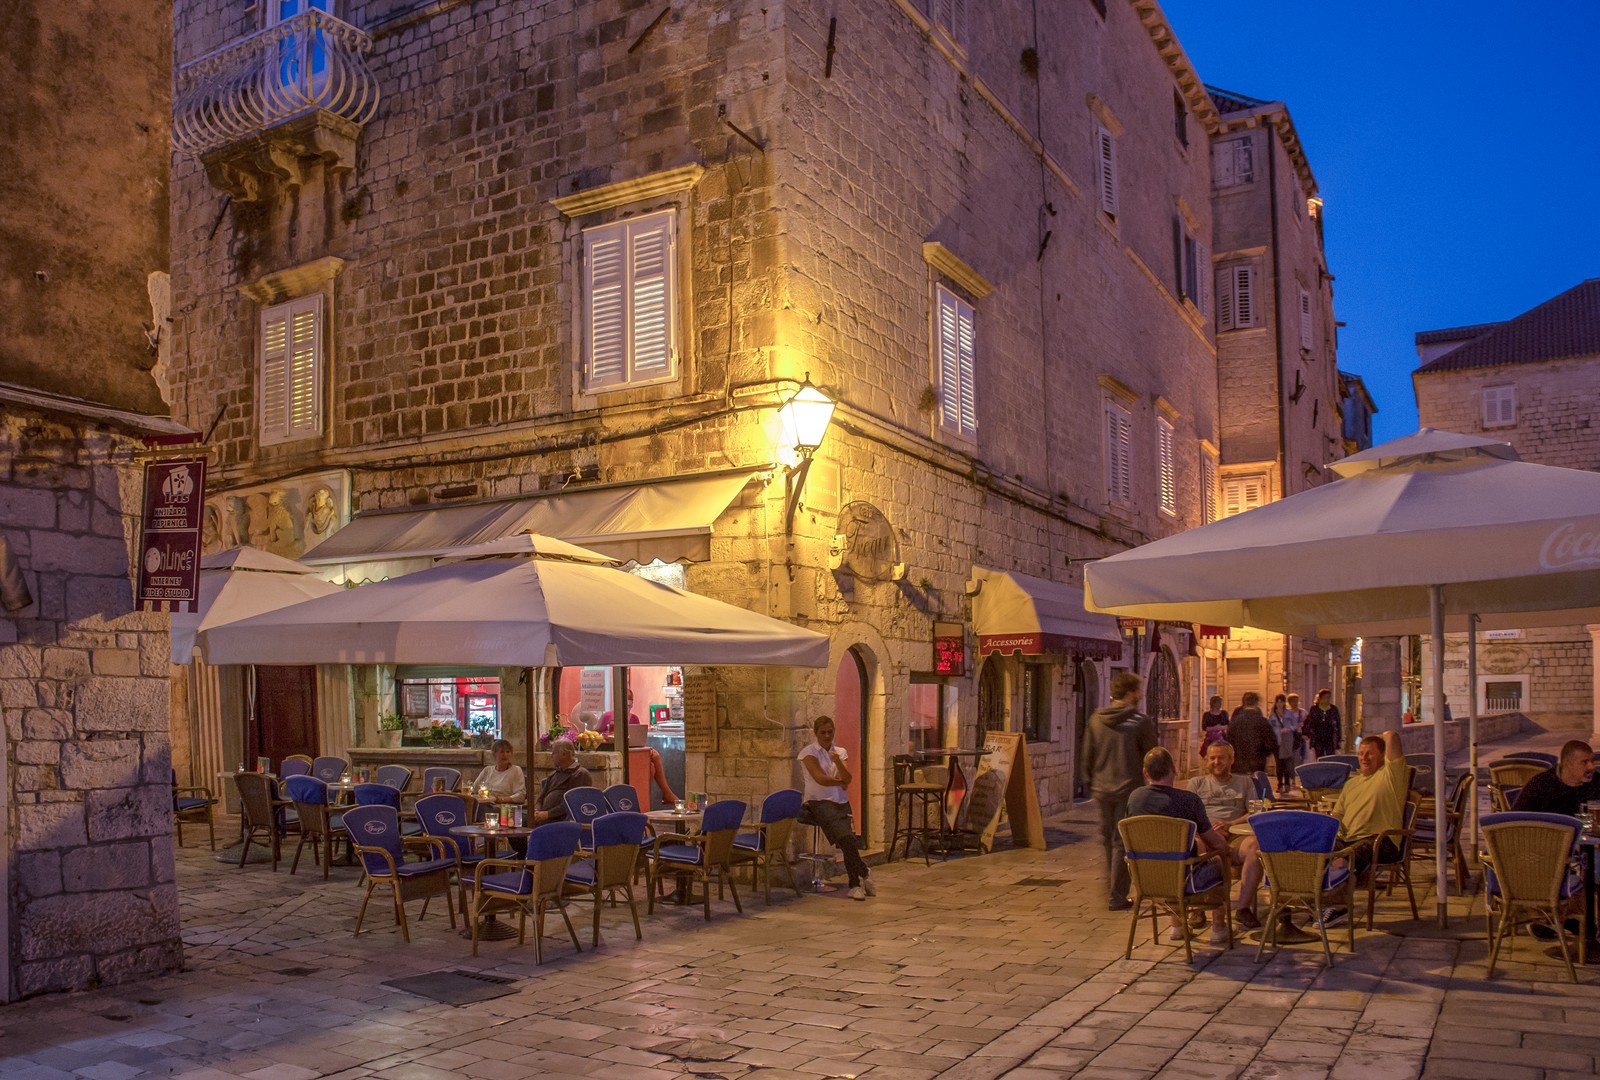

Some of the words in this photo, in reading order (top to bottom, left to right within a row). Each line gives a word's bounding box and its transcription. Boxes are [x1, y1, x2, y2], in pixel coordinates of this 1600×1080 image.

[165, 491, 190, 504] Iris
[154, 505, 187, 517] KNJIŽARA
[152, 518, 188, 529] PAPIRNICA
[150, 576, 182, 586] INTERNET
[144, 587, 164, 597] VIDEO
[164, 588, 191, 598] STUDIO
[983, 636, 1034, 648] Accessories
